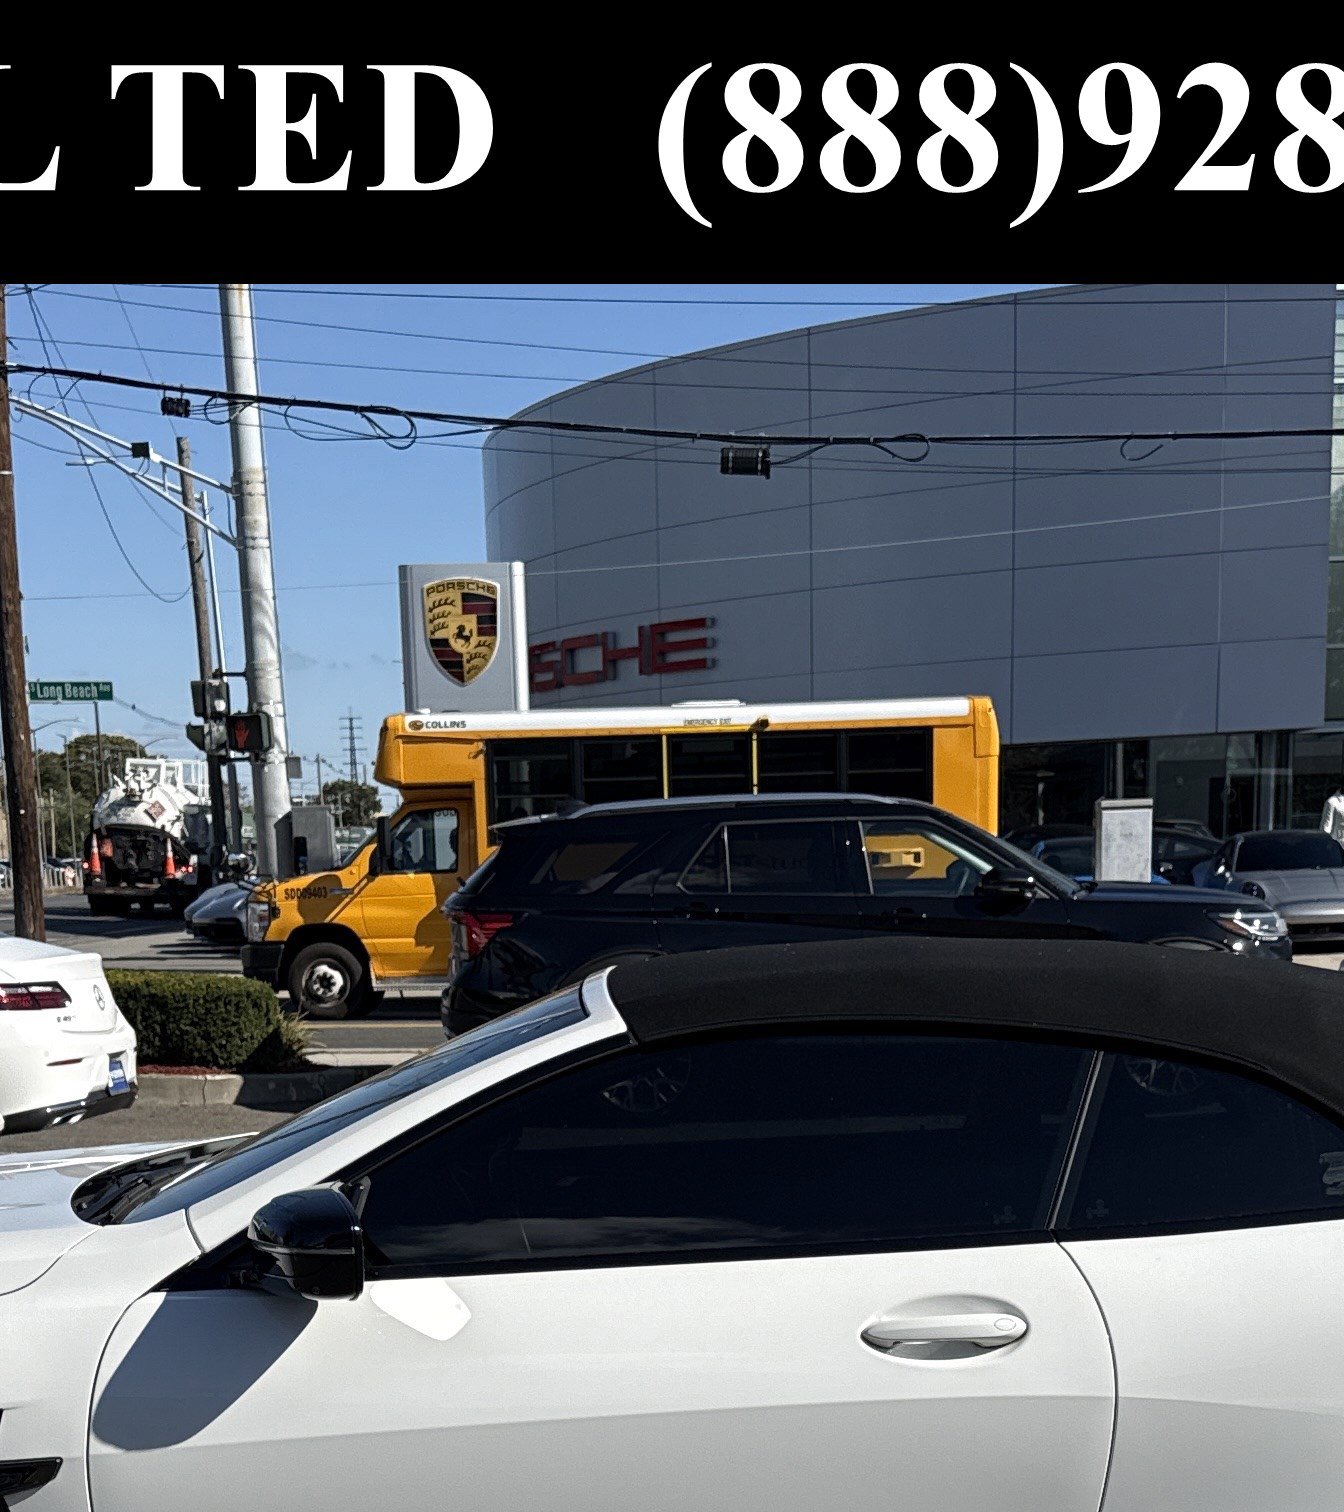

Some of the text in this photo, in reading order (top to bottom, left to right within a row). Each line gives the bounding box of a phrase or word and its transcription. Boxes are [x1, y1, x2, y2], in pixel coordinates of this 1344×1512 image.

[425, 581, 497, 597] PORSCHE
[36, 682, 63, 700] Long
[64, 683, 98, 698] Beach
[425, 720, 467, 729] COLLINS
